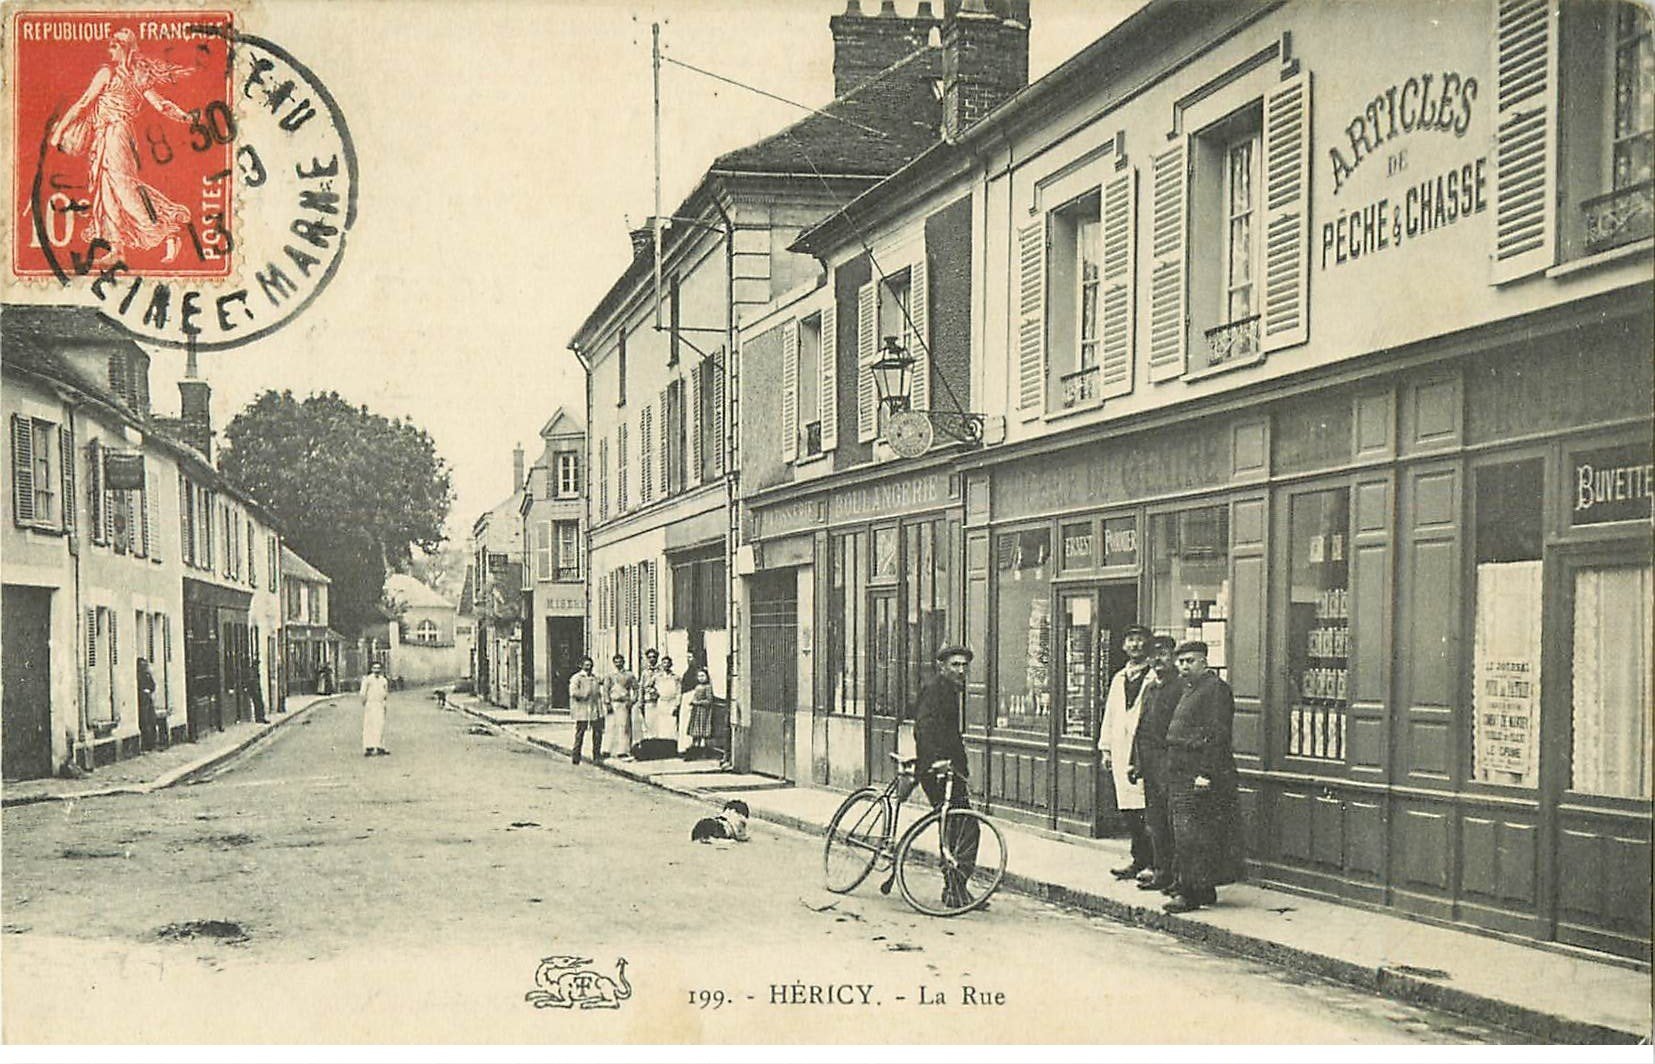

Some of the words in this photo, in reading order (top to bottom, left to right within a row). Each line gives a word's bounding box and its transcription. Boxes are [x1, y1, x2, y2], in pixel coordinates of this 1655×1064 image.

[1328, 71, 1479, 196] ARTICLES
[1386, 148, 1409, 178] DE
[255, 153, 341, 307] MARNE
[1393, 205, 1402, 247] &
[1405, 157, 1488, 239] CHASSE
[71, 237, 203, 335] SEINE
[216, 290, 254, 332] ET
[833, 474, 939, 518] BOULANGERIE
[1575, 464, 1653, 511] BUVETTE
